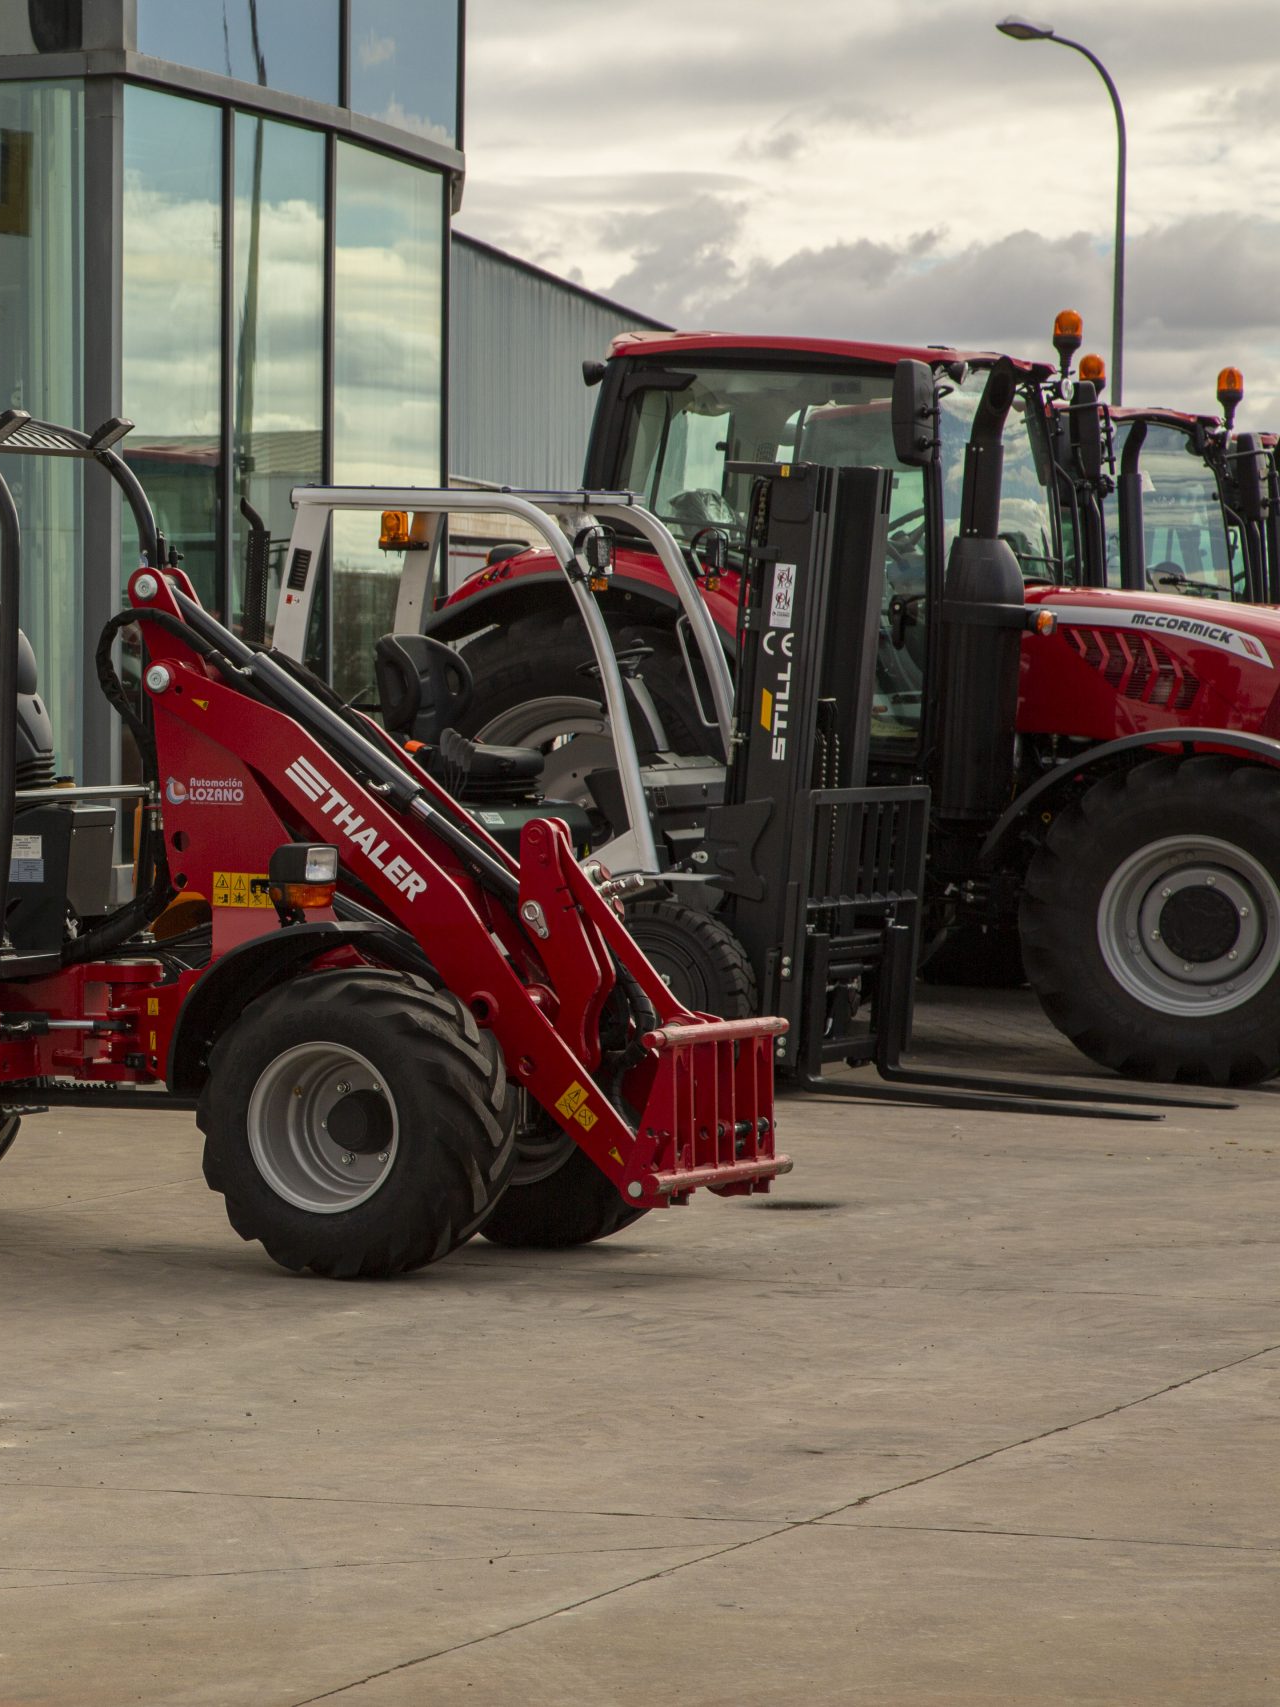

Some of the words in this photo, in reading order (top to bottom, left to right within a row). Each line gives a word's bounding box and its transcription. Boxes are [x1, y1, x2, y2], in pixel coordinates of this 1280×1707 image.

[771, 661, 792, 761] STILL
[189, 777, 243, 787] Automoción
[189, 788, 244, 802] LOZANO
[320, 787, 428, 903] THALER
